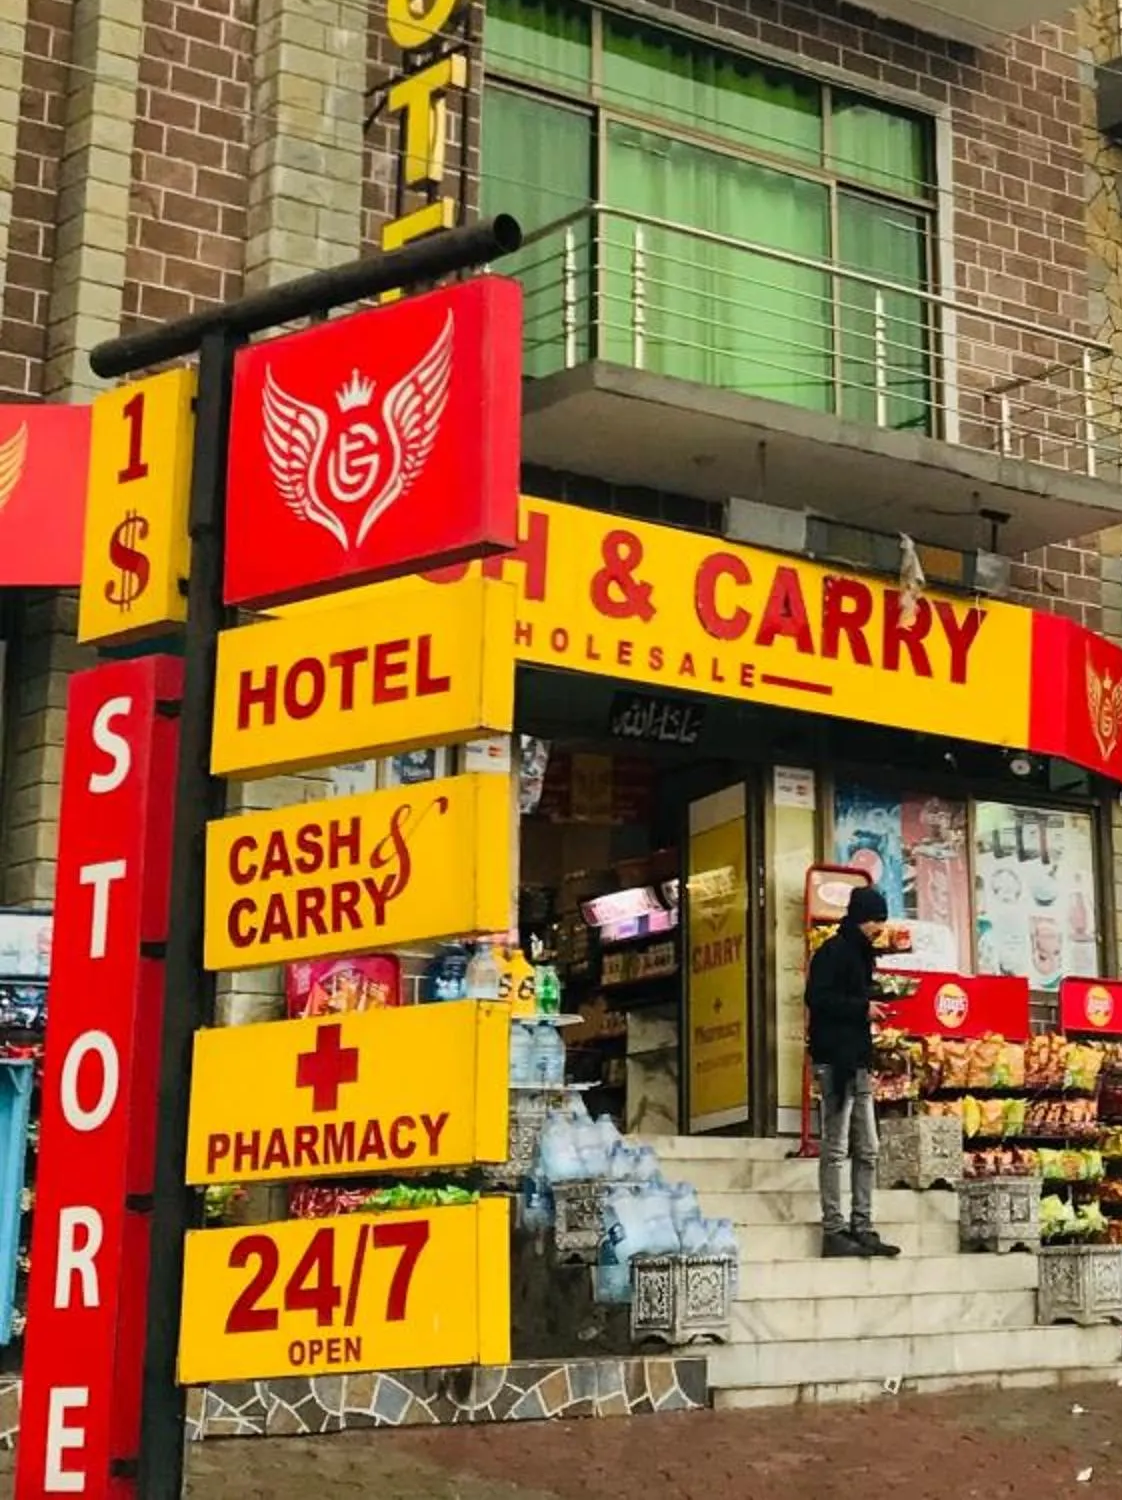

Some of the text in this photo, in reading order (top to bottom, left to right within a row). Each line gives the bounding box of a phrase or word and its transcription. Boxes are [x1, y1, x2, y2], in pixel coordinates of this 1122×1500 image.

[118, 390, 149, 484] 1
[590, 529, 656, 622] &
[694, 552, 988, 685] CARRY
[237, 634, 451, 731] HOTEL
[515, 620, 754, 688] HOLESALE
[228, 816, 361, 886] CASH
[227, 874, 397, 949] CARRY
[44, 697, 133, 1492] STORE
[206, 1112, 450, 1175] PHARMACY
[224, 1219, 431, 1334] 24/7
[288, 1336, 363, 1367] OPEN
